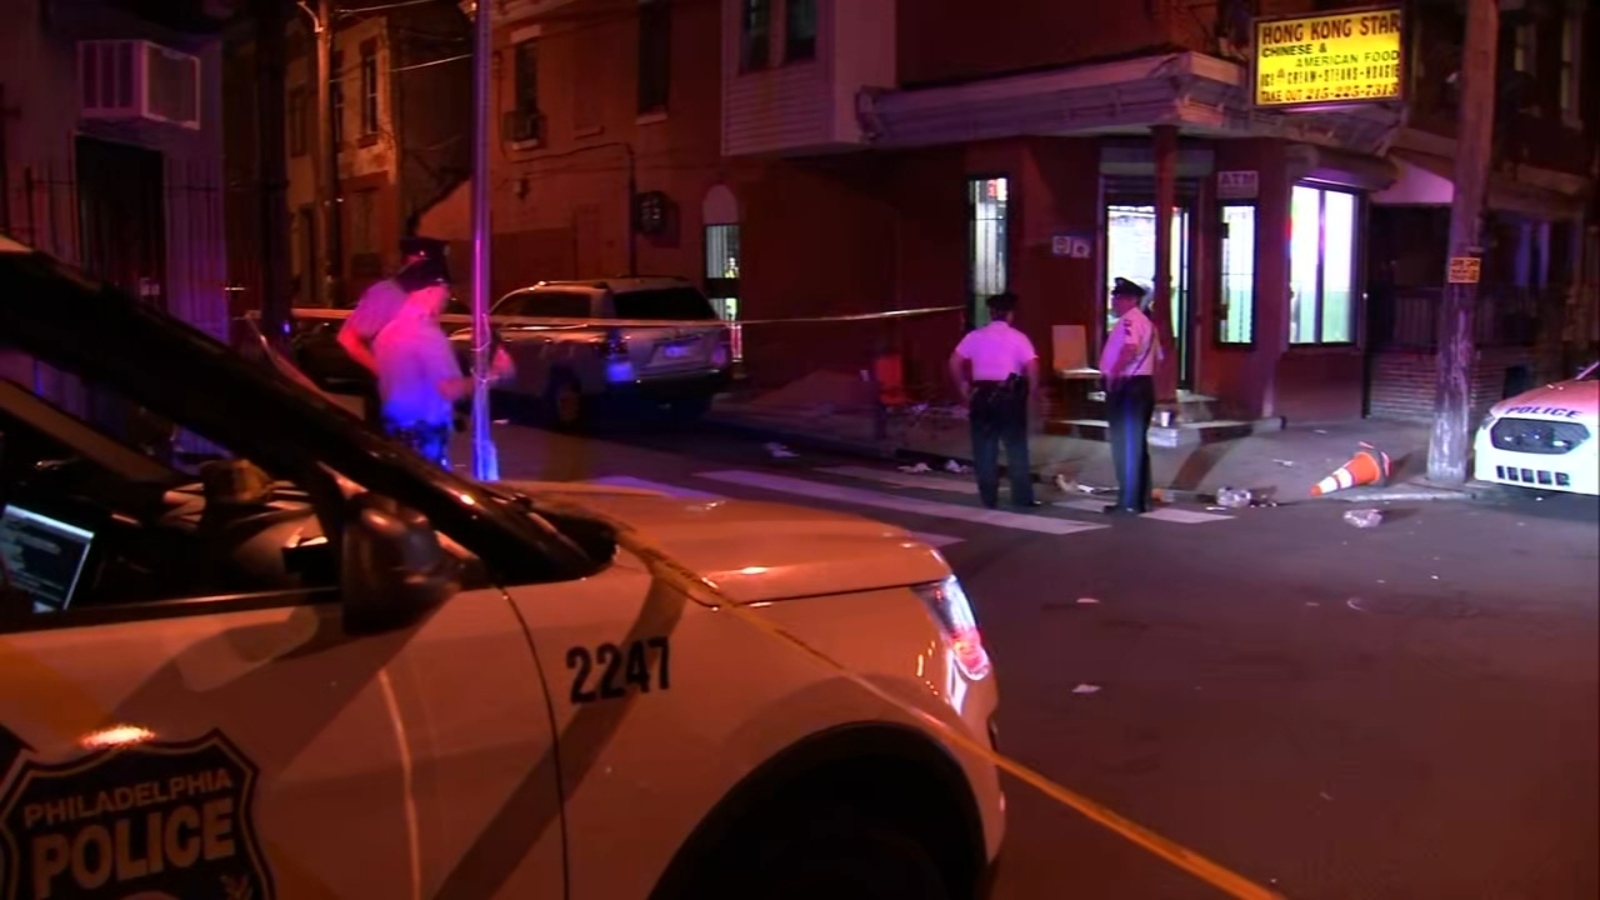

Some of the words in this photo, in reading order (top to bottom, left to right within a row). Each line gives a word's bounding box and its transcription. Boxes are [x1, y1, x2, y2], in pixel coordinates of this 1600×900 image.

[1262, 23, 1303, 45] HONG
[1310, 19, 1352, 41] KONG
[1360, 13, 1400, 35] STAR
[1262, 44, 1313, 58] CHINESE
[1296, 54, 1358, 68] AMERICAN
[1365, 50, 1400, 62] FOOD
[1220, 173, 1256, 186] ATM
[1505, 406, 1583, 418] POLICE
[566, 635, 670, 703] 2247
[23, 767, 234, 829] PHILADELPHIA
[32, 797, 236, 900] POLICE
